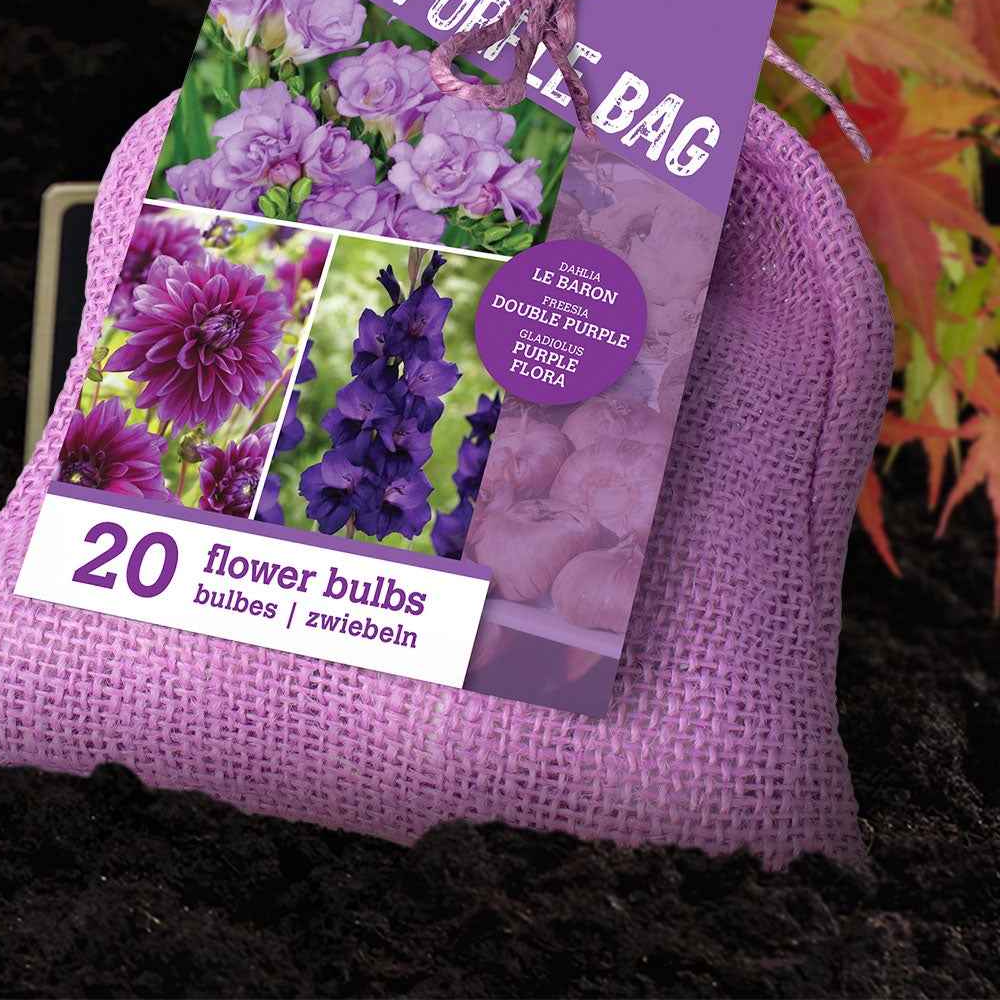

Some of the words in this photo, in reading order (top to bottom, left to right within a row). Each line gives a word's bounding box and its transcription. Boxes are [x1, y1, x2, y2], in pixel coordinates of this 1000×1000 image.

[592, 71, 721, 177] BAG
[532, 268, 555, 285] LE
[556, 275, 619, 305] BARON
[559, 262, 601, 283] DAHLIA
[491, 295, 562, 327] DOUBLE
[563, 316, 630, 349] PURPLE
[542, 295, 590, 319] FREESIA
[512, 341, 579, 373] PURPLE
[519, 328, 585, 357] GLADIOLUS
[509, 359, 566, 388] FLORA
[72, 521, 179, 598] 20
[203, 543, 317, 593] flower
[323, 568, 427, 616] bulbs
[193, 583, 279, 619] bulbes
[305, 609, 419, 649] zwiebeln
